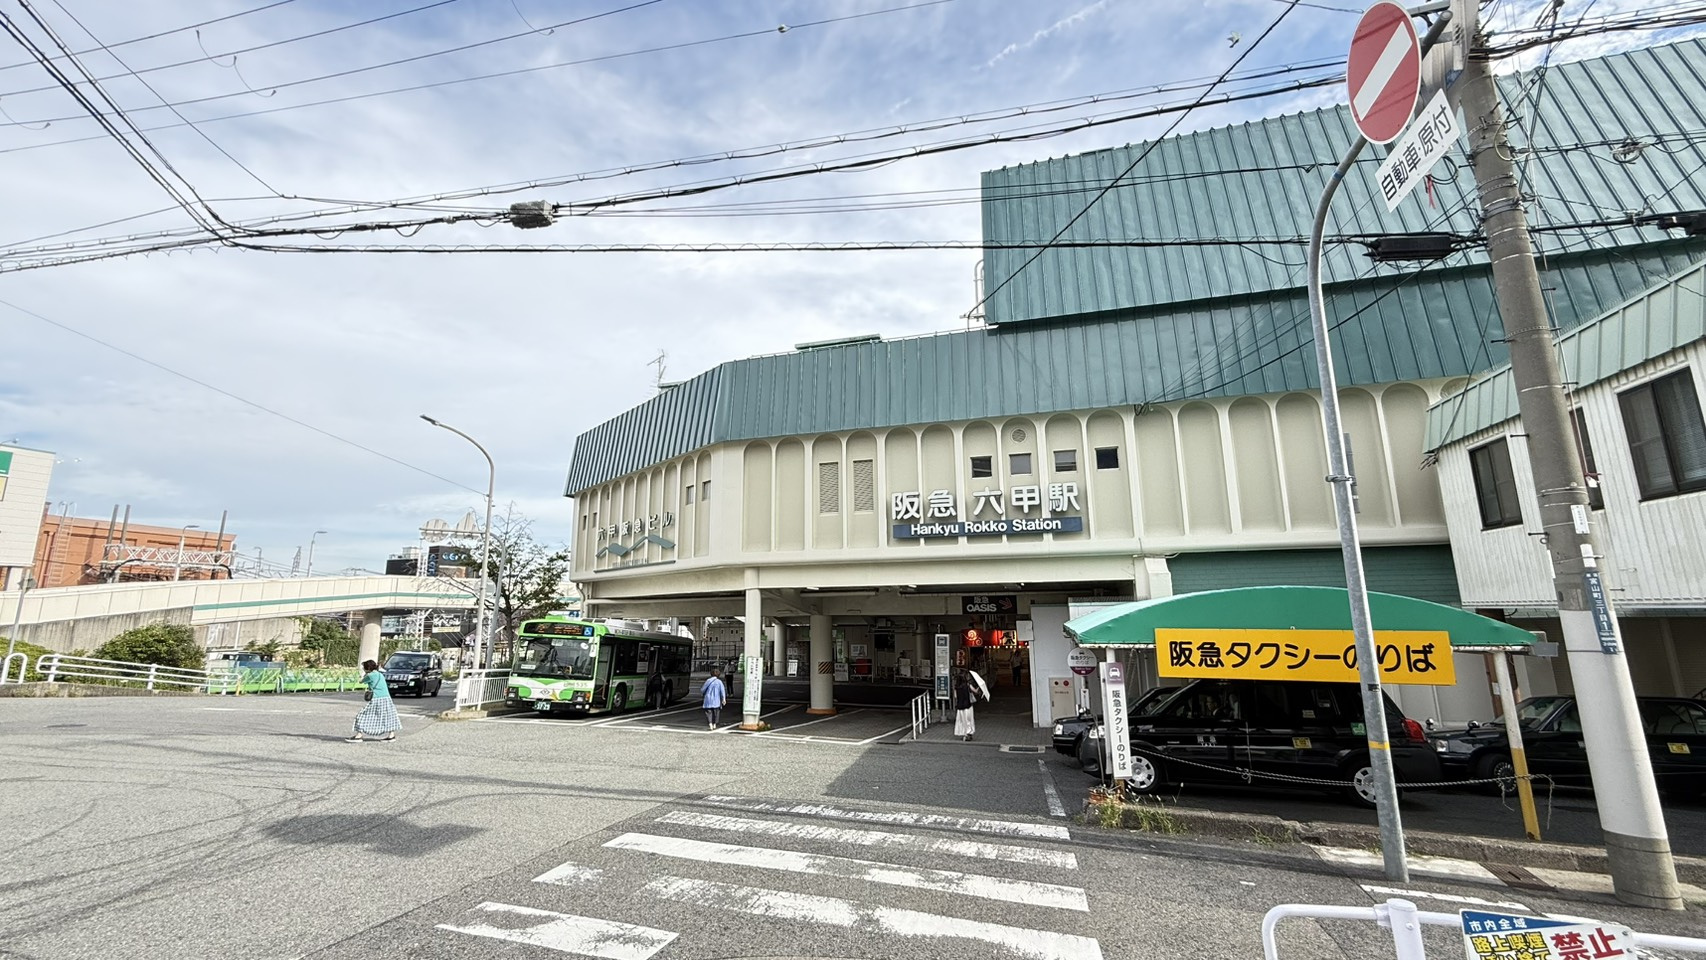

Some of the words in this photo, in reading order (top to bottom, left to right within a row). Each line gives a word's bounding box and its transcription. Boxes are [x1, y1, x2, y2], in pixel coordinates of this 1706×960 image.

[973, 482, 1081, 515] 六甲駅
[911, 522, 958, 536] Hankyu
[965, 521, 1007, 533] Rokko
[1012, 517, 1061, 531] Station
[966, 603, 997, 612] OASIS
[1169, 641, 1437, 673] 阪急タクシーのりば
[1112, 690, 1127, 771] 阪急タクシーのりば
[1469, 918, 1527, 932] 市内全域
[1471, 931, 1547, 953] 路上喫煙
[1551, 928, 1622, 960] 禁止
